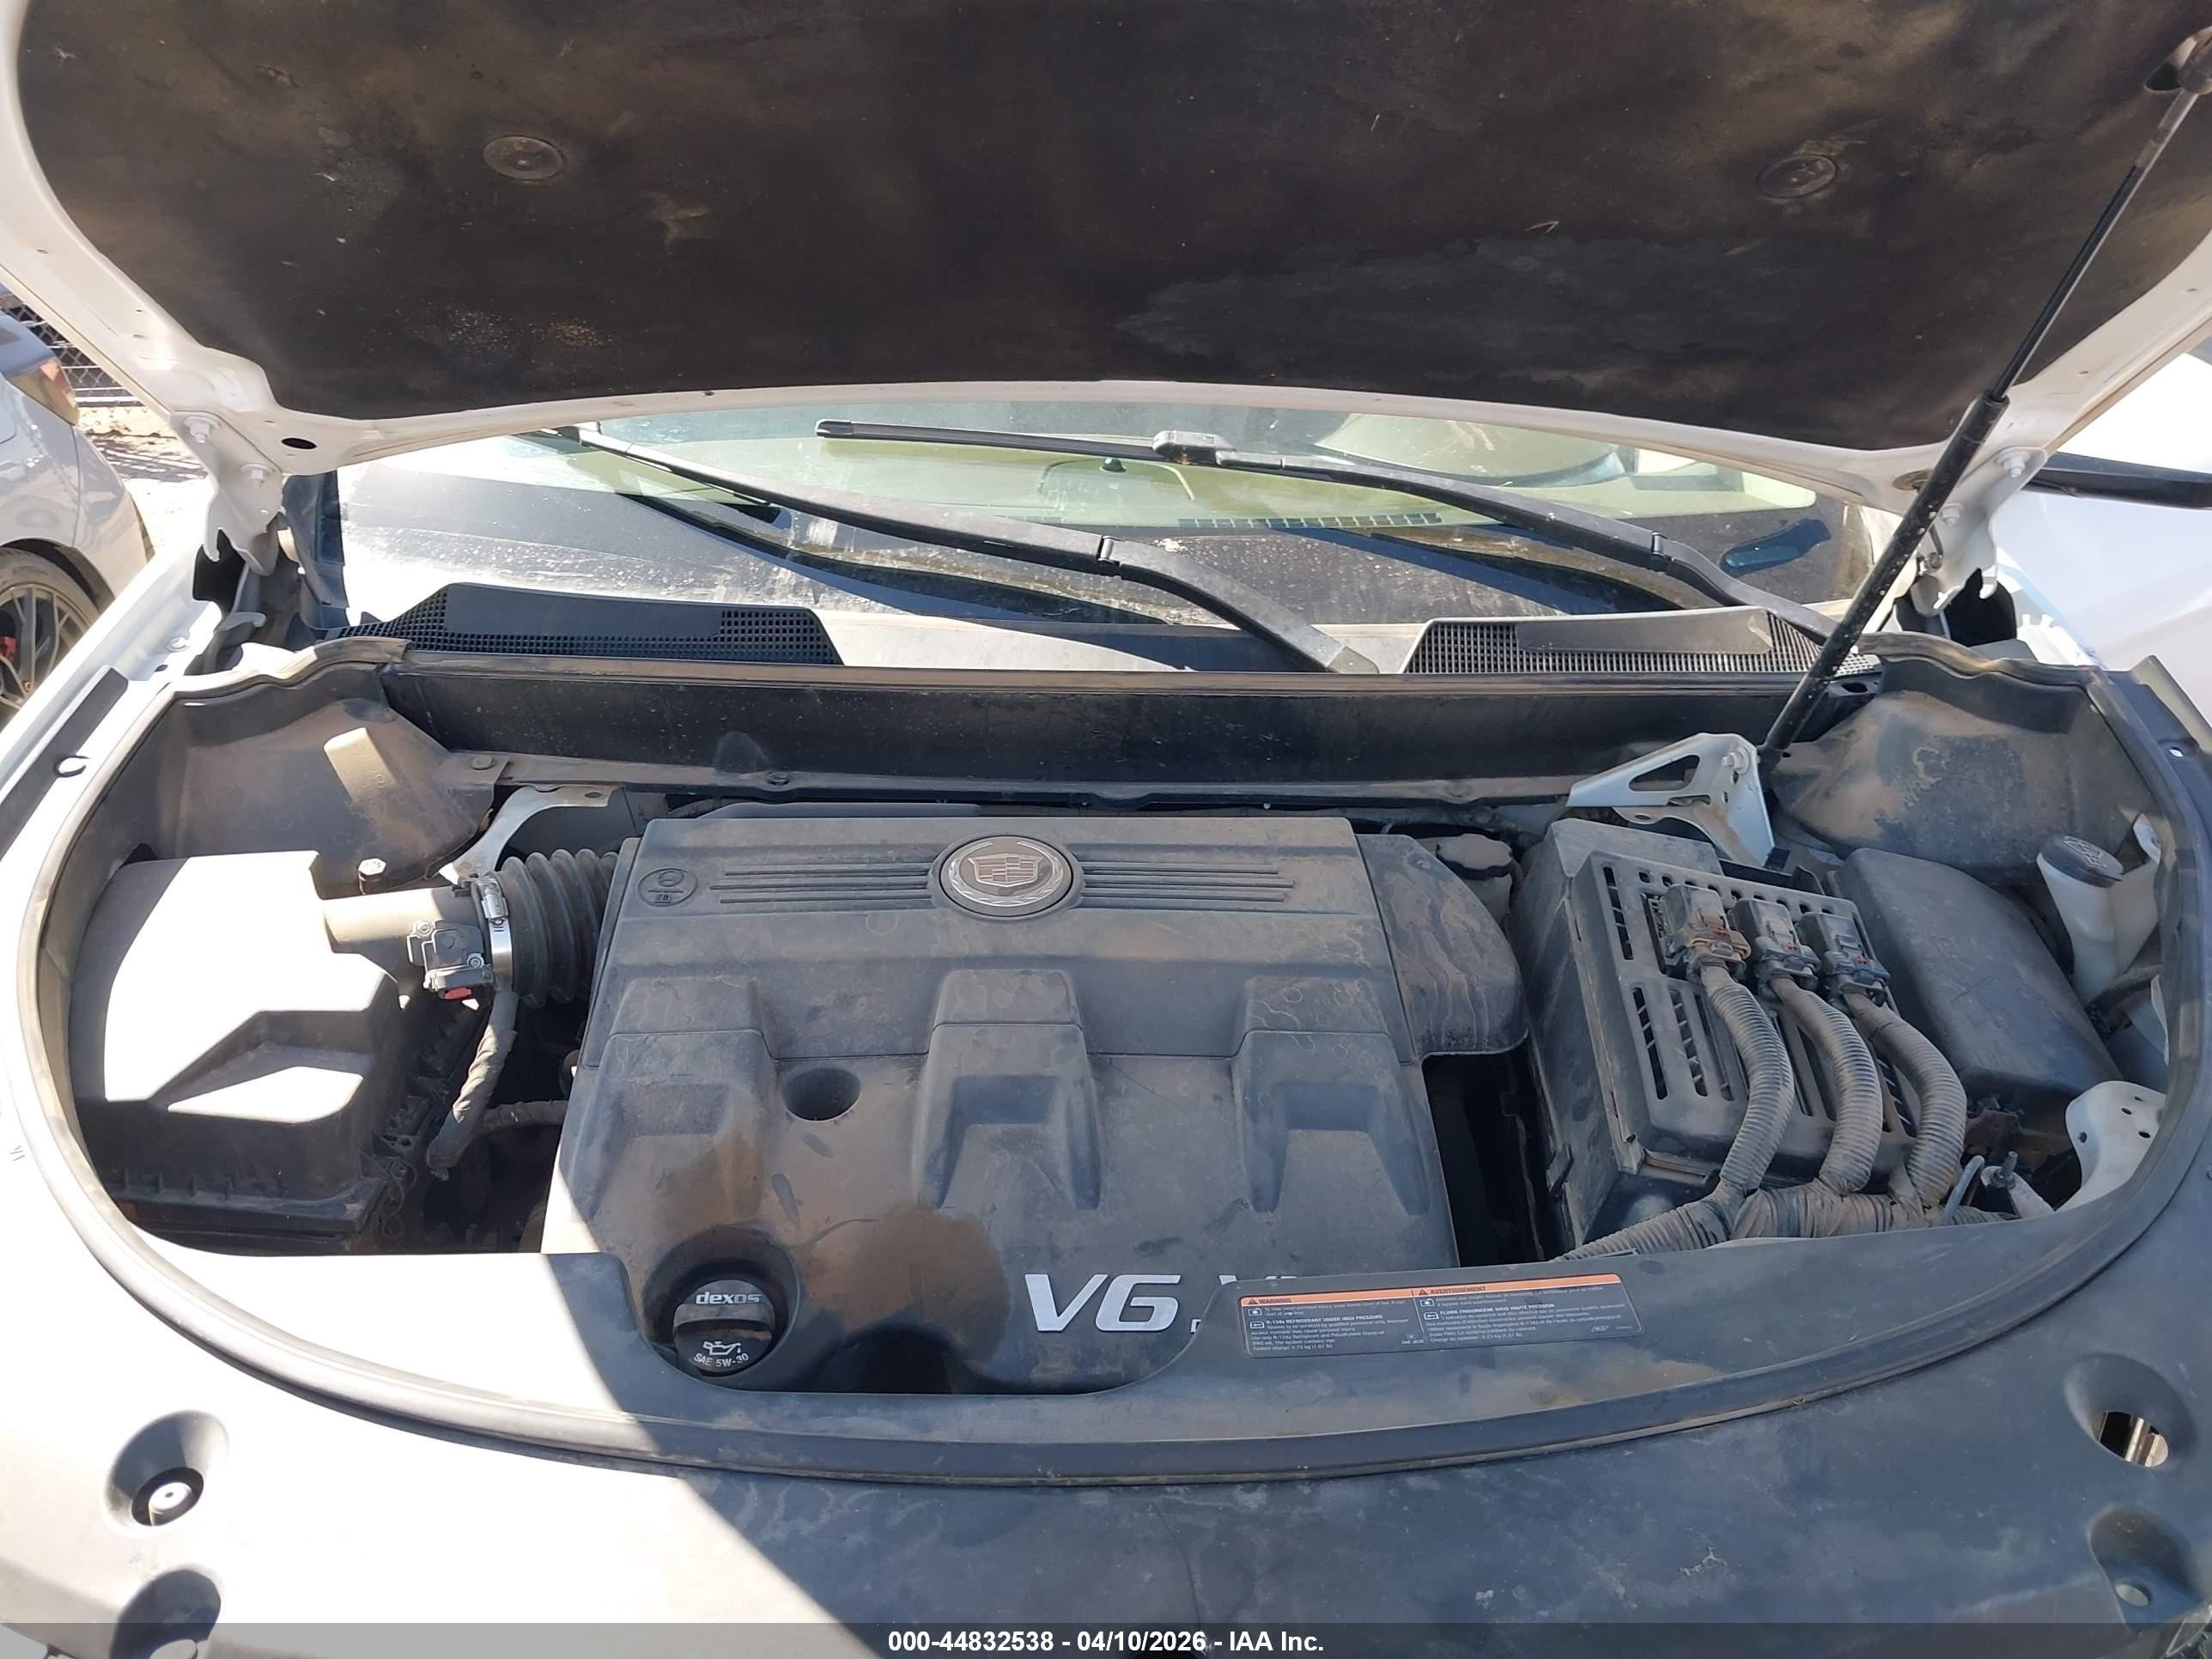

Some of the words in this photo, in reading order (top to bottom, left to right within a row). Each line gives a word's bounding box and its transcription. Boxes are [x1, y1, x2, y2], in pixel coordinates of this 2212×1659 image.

[696, 1291, 763, 1304] dexos
[1025, 1274, 1181, 1330] V6
[693, 1352, 714, 1367] SAE
[715, 1352, 749, 1367] 5W-30
